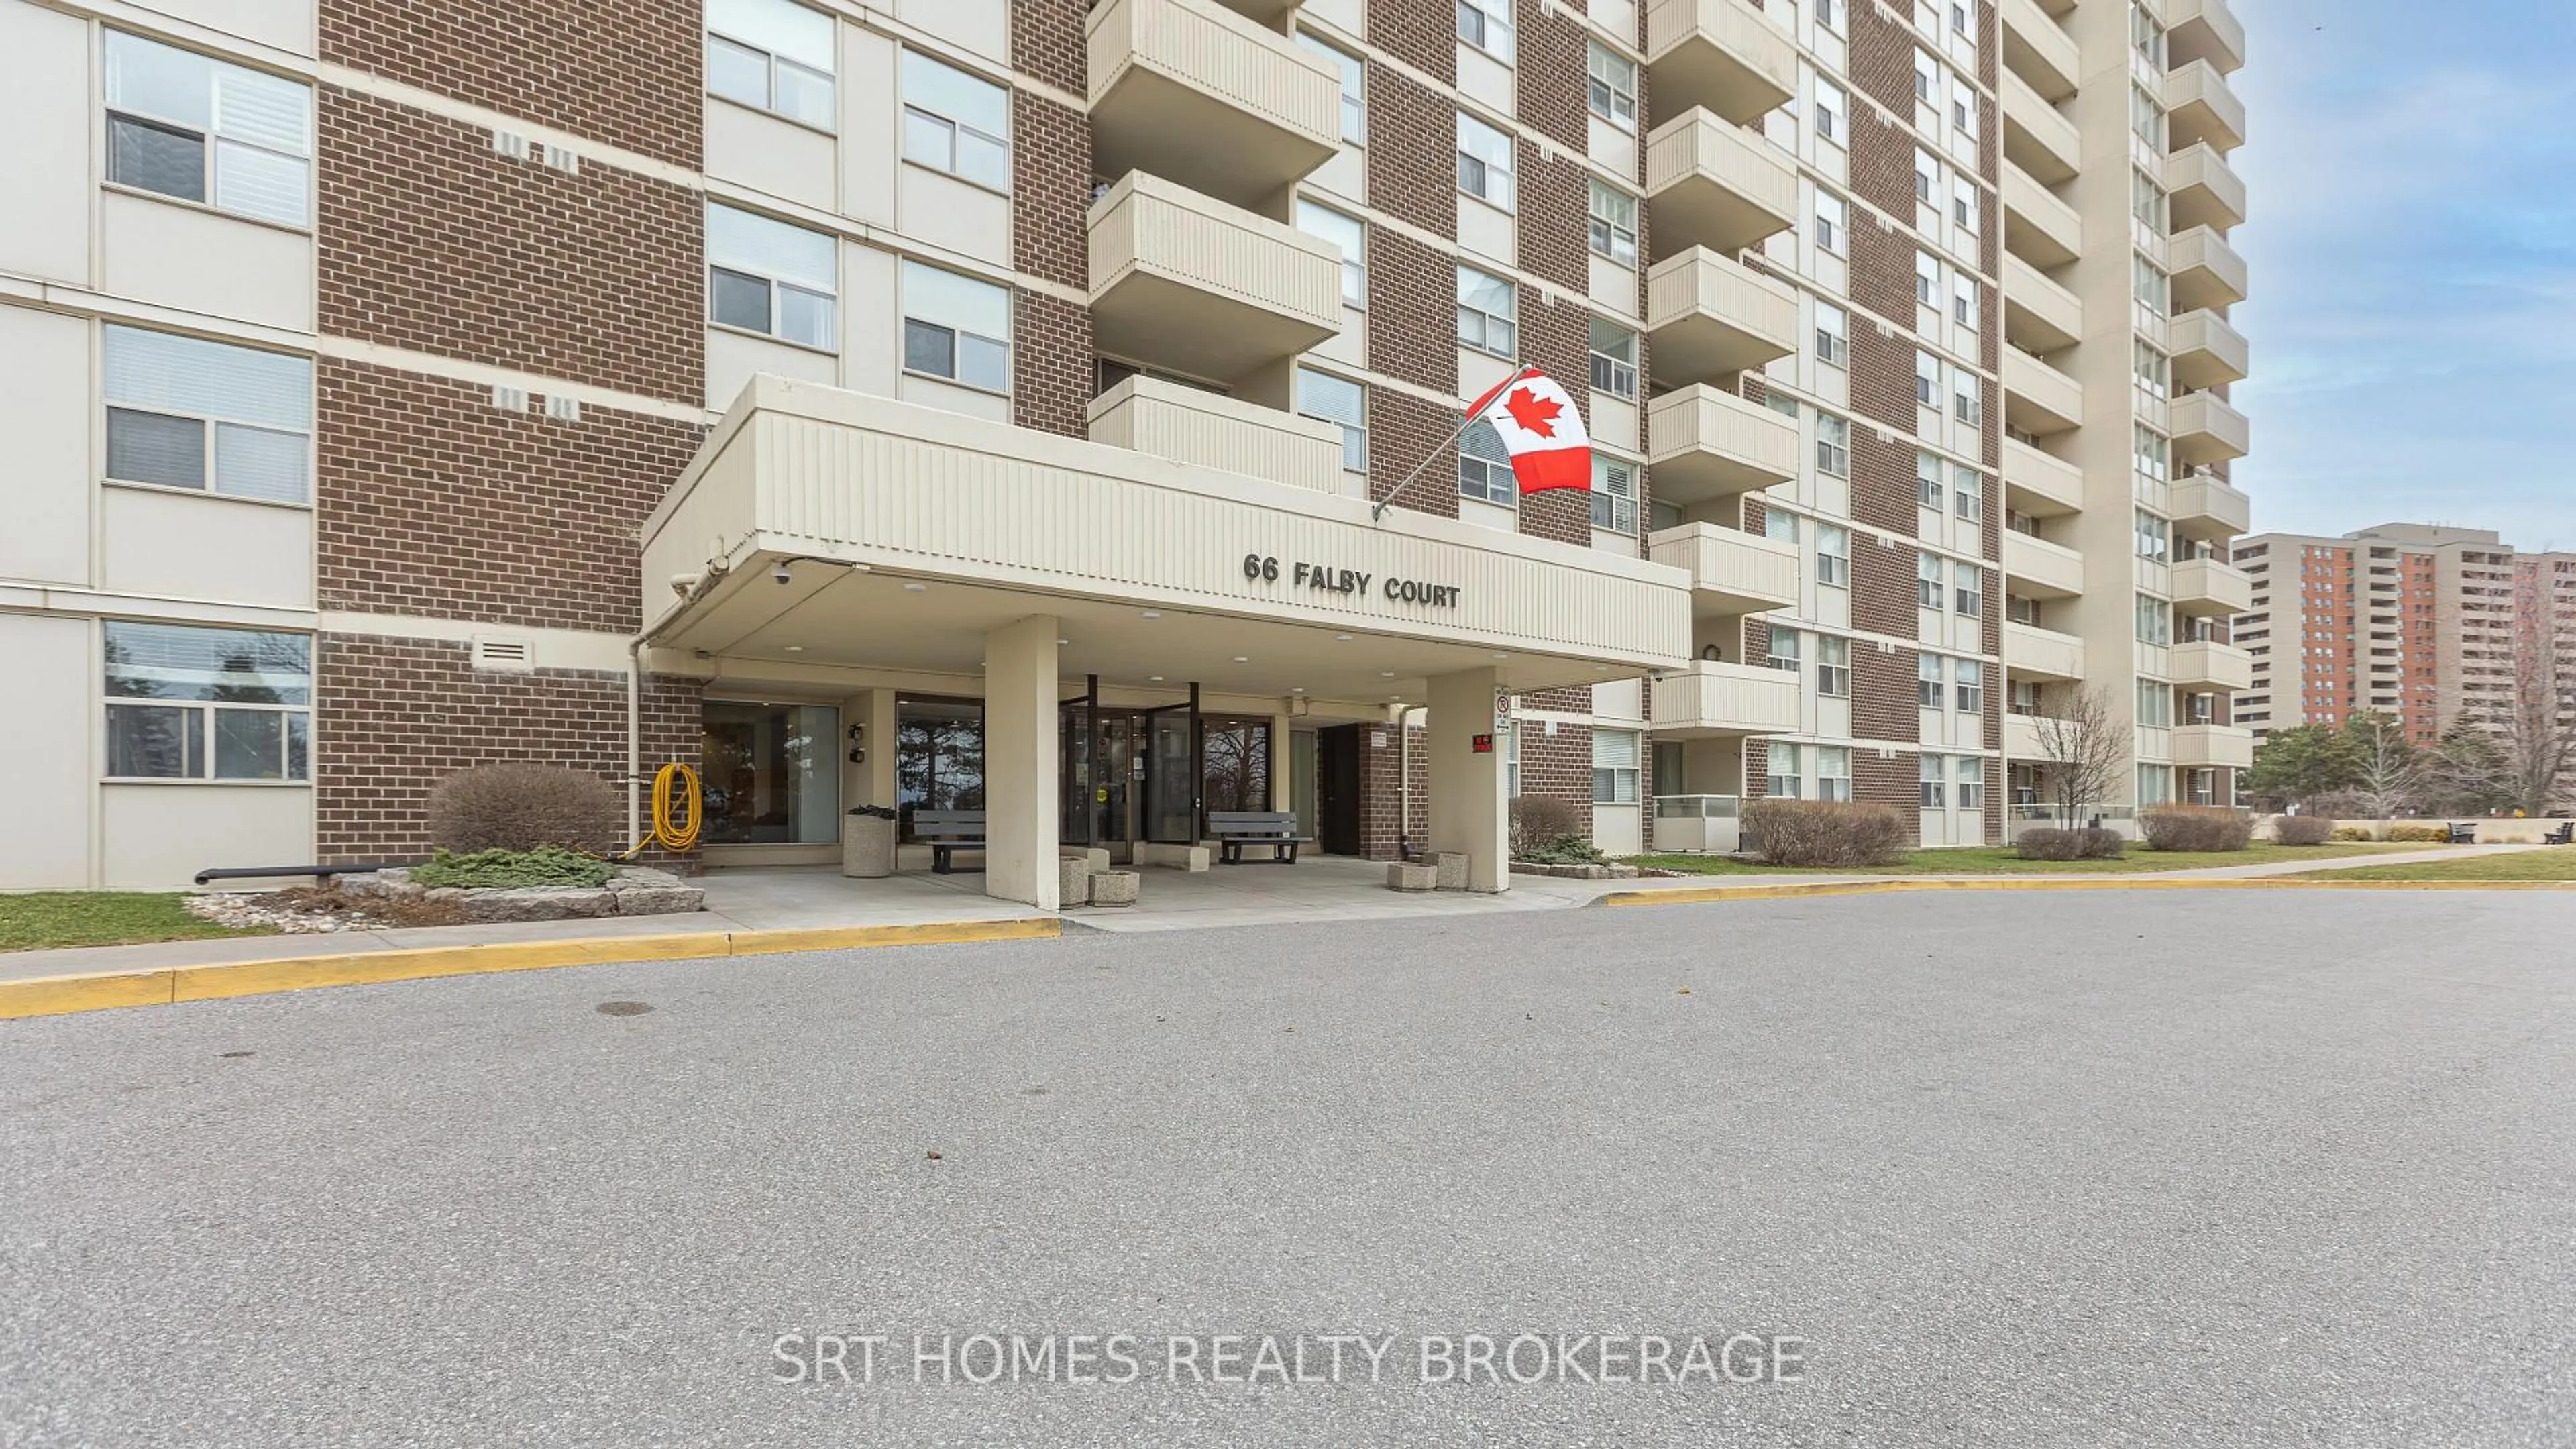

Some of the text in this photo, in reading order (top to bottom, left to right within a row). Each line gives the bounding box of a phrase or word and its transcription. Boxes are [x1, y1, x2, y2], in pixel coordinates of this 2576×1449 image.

[1244, 554, 1460, 608] 66 FALBY COURT
